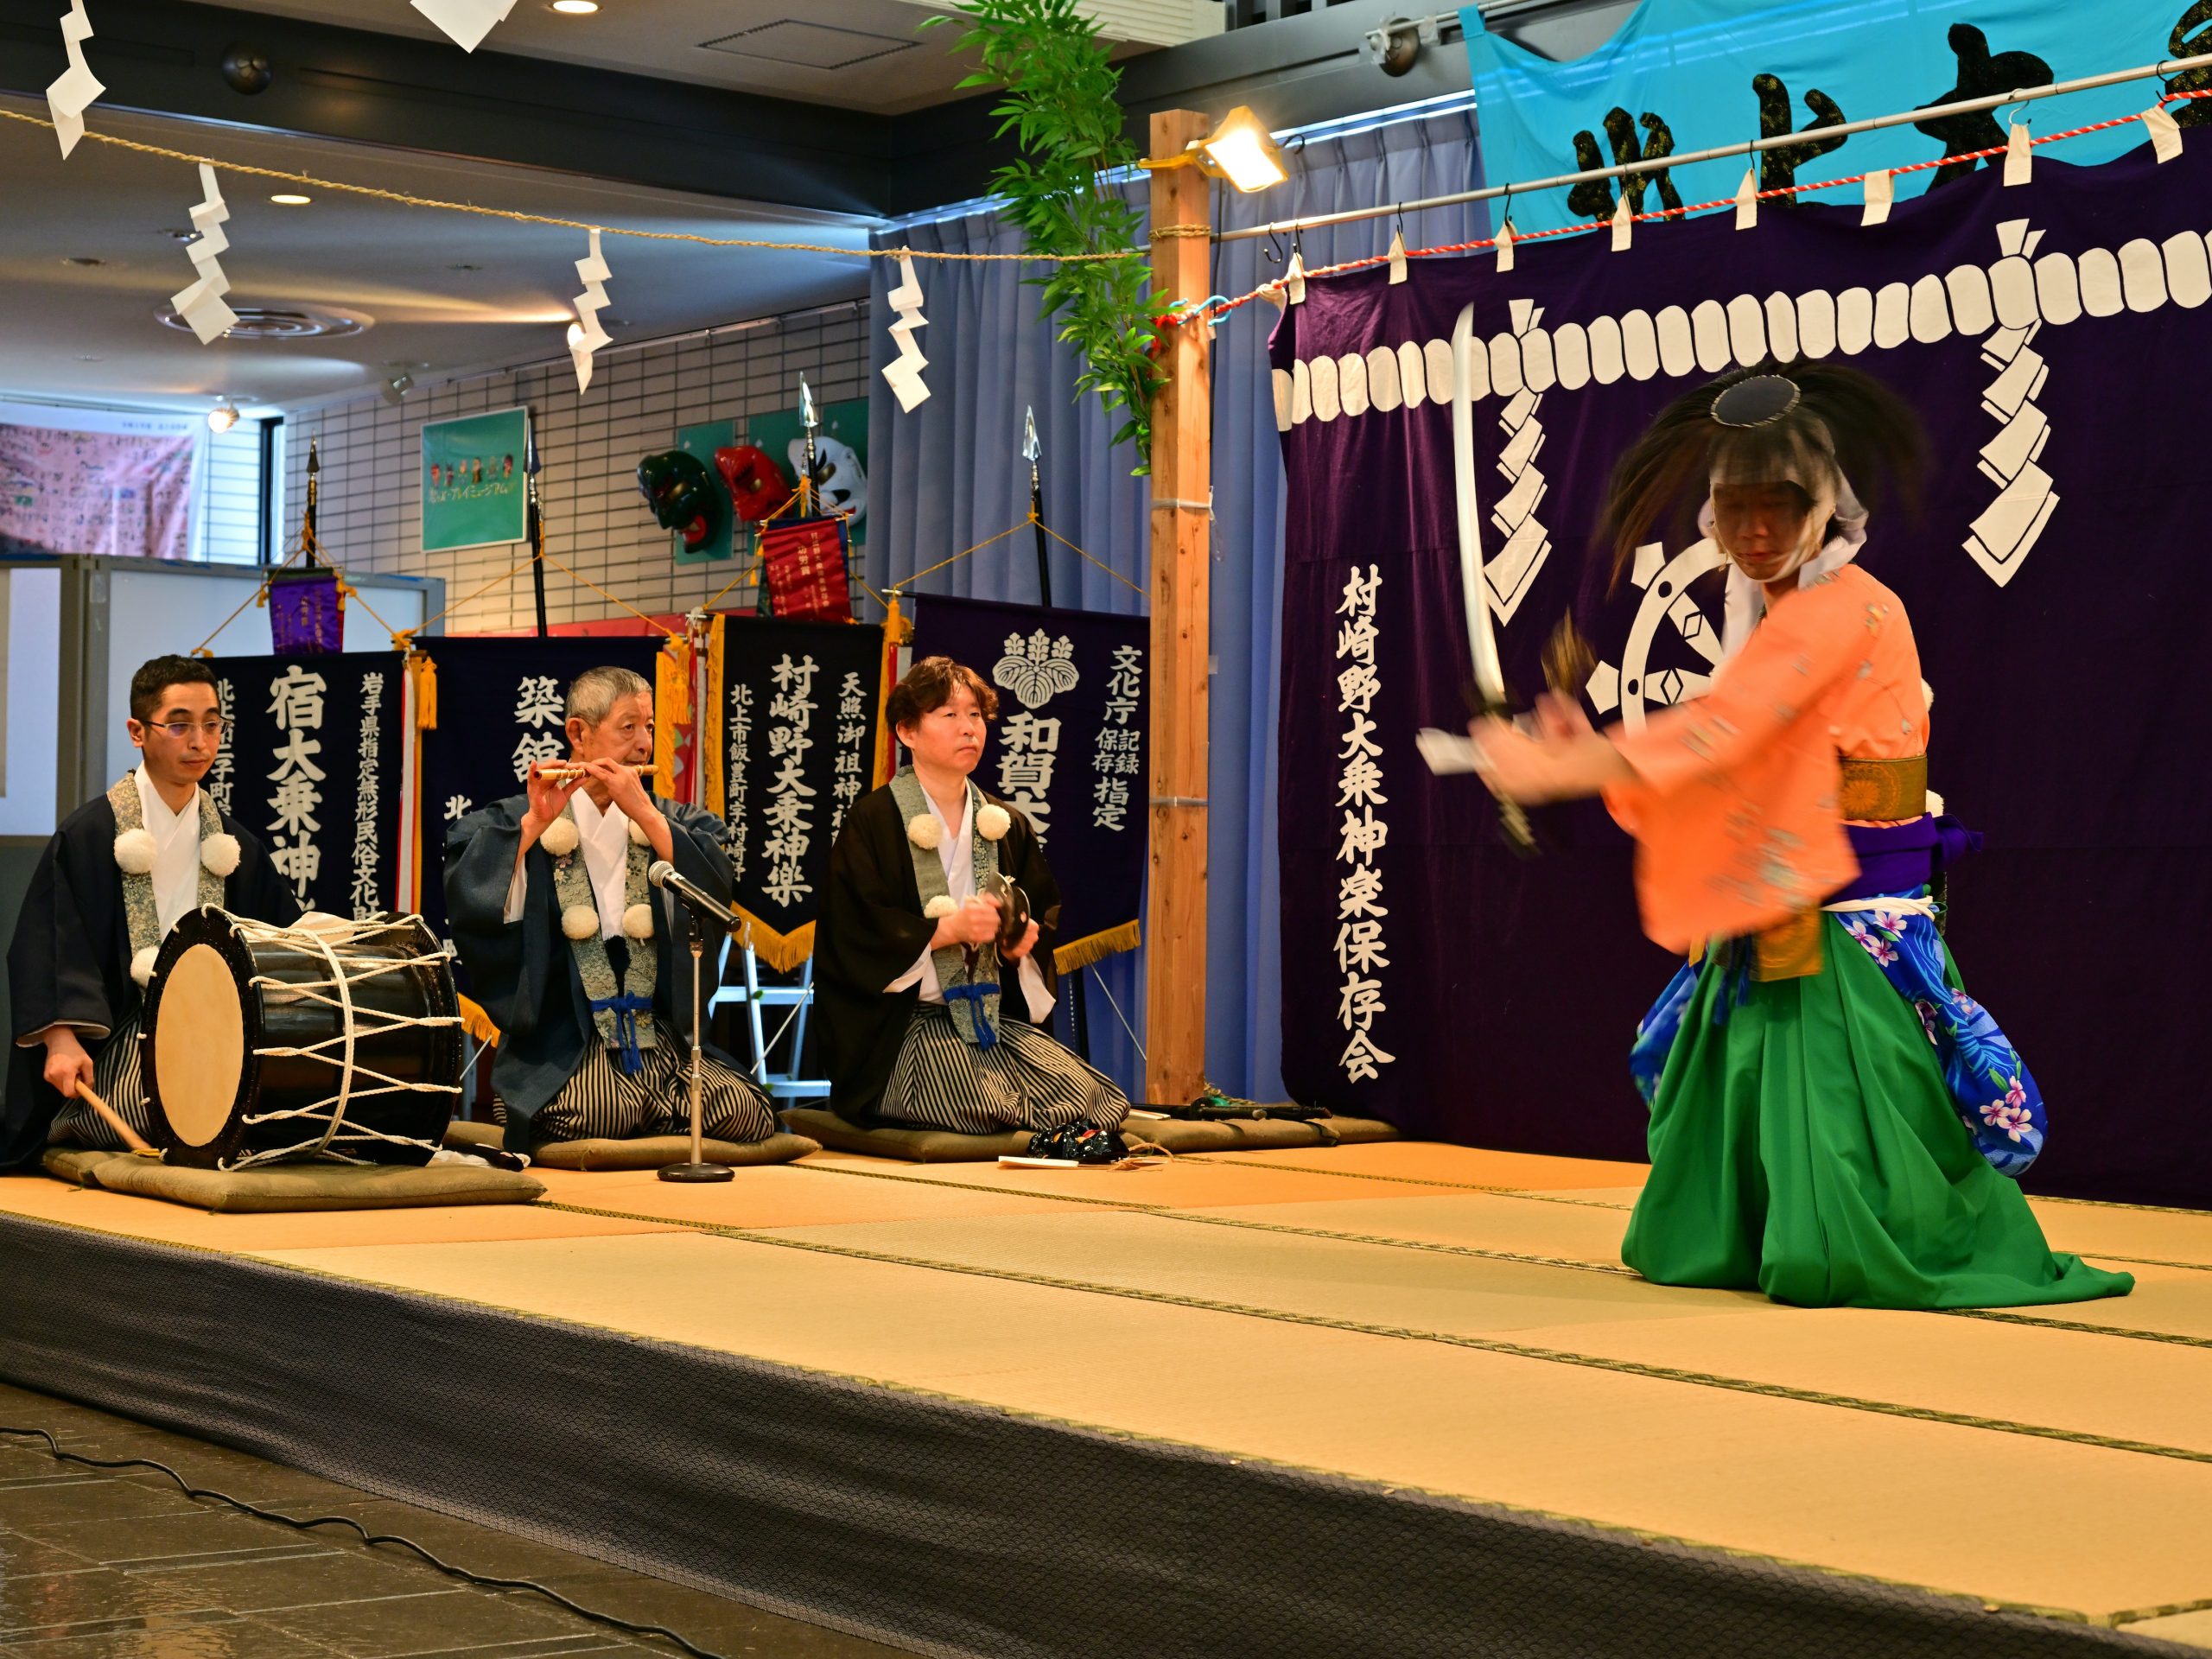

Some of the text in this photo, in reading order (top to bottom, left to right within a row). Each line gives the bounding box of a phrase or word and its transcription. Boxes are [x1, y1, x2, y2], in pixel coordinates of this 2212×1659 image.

[265, 664, 327, 912] 宿大乗神
[831, 671, 867, 848] 天照御祖神
[996, 710, 1062, 854] 和賀大
[1334, 563, 1395, 1084] 村崎野大乗神楽保存会
